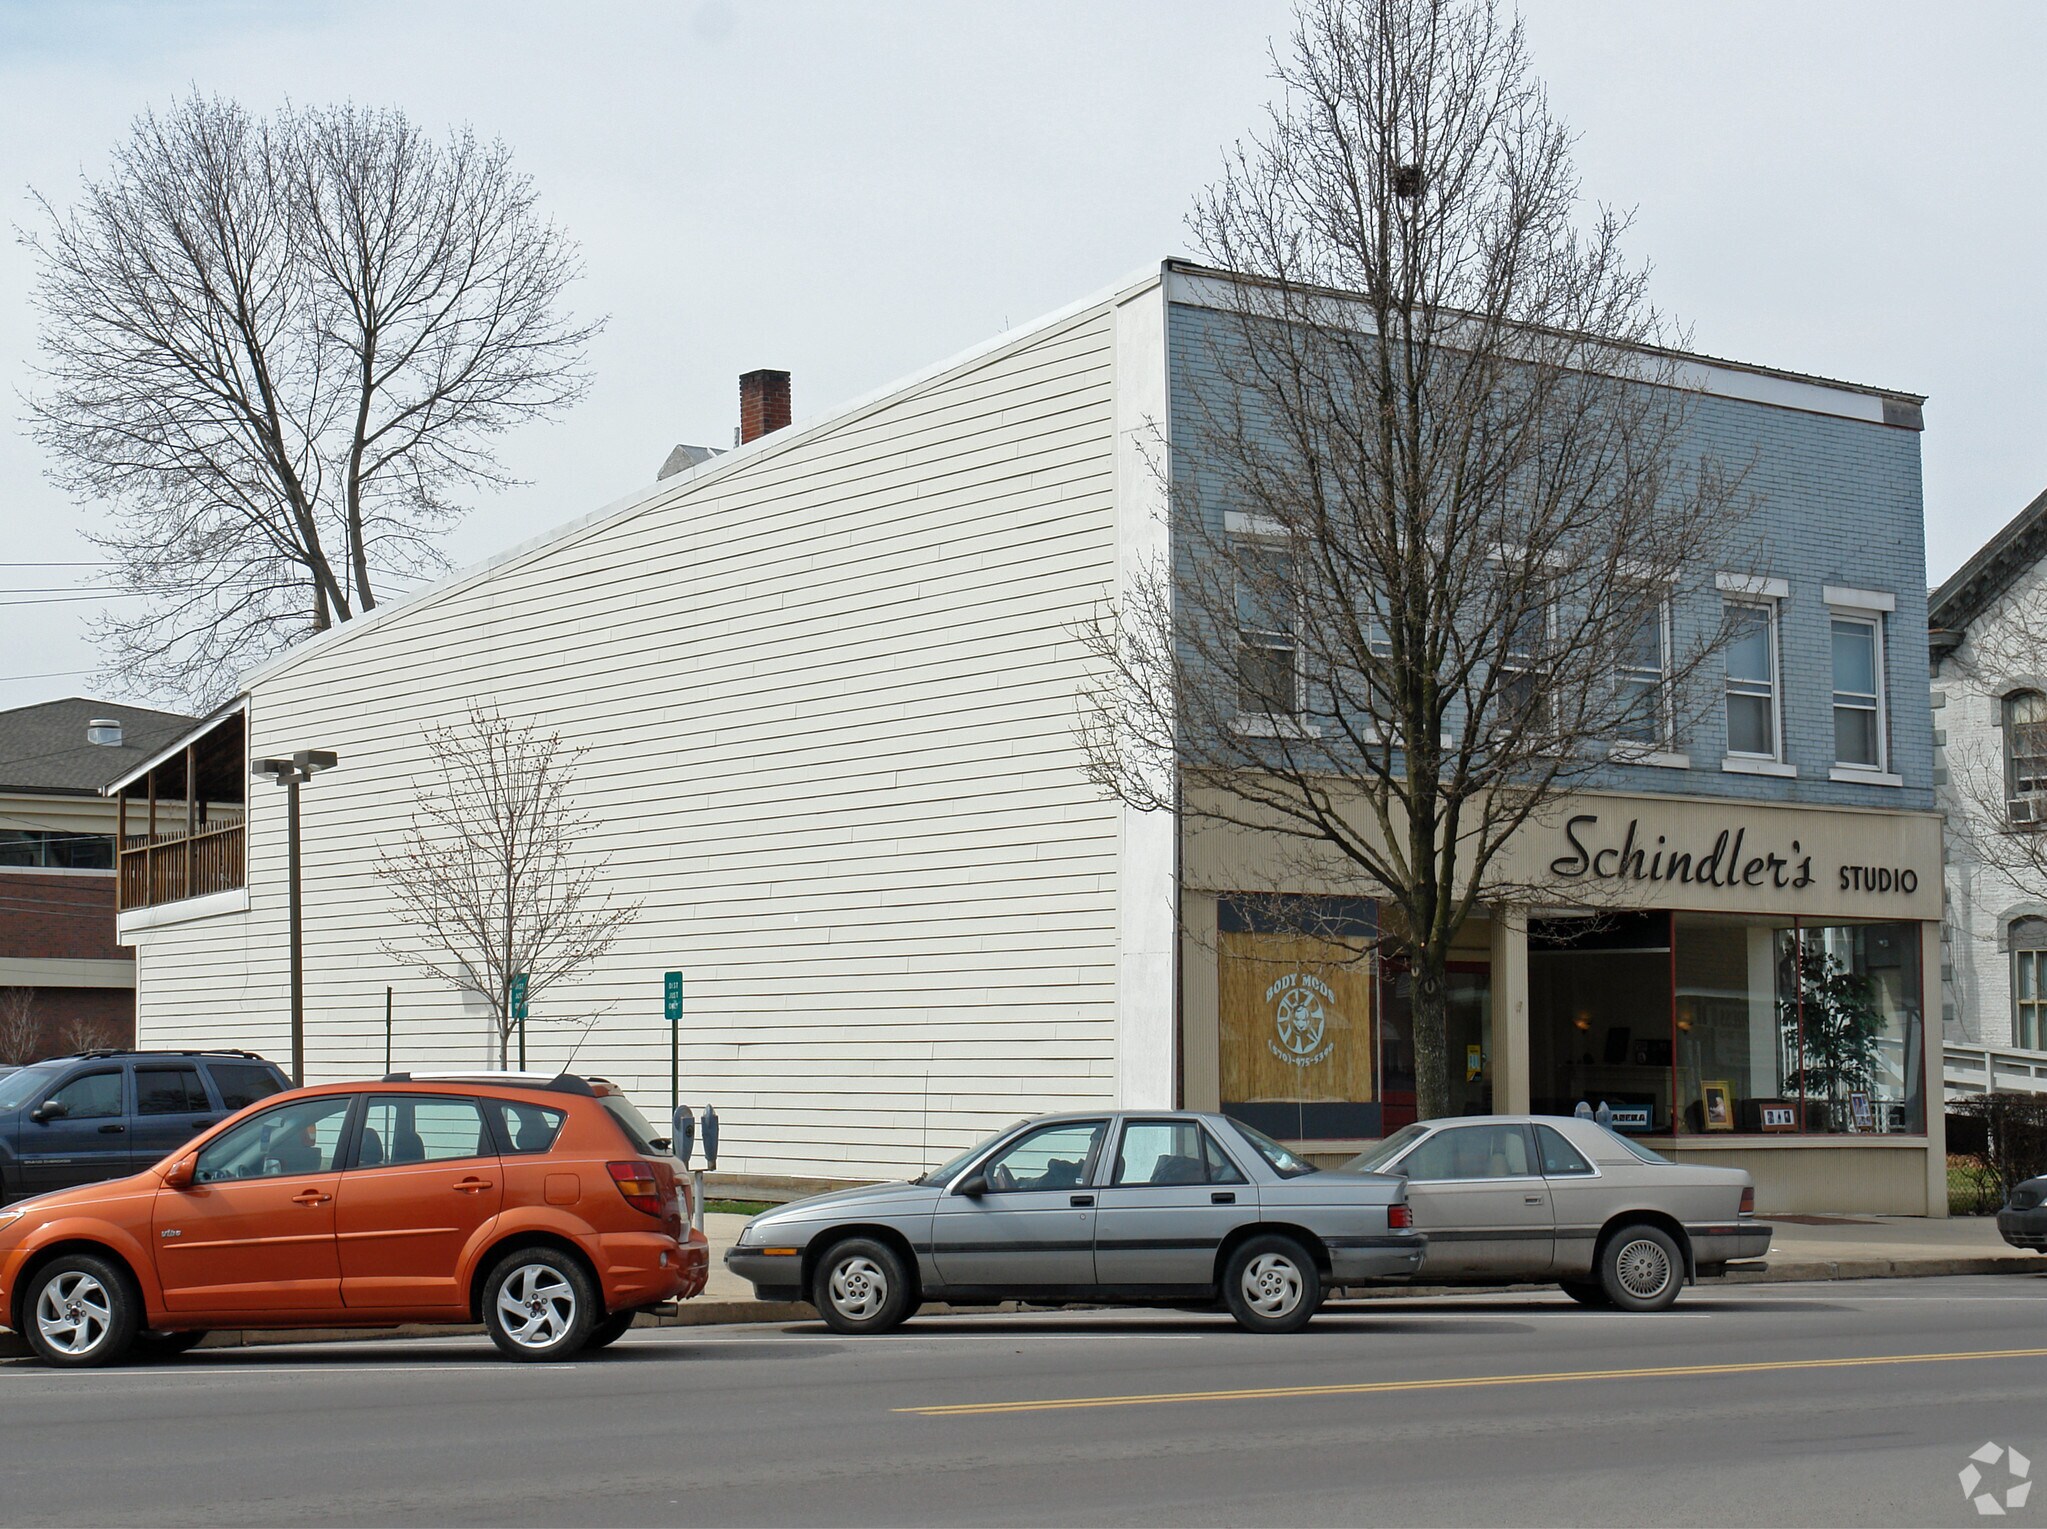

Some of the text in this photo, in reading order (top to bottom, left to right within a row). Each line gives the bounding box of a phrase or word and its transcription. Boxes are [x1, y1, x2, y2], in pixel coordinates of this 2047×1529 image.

[1550, 815, 1918, 894] Schindler's STUDIO
[1265, 973, 1298, 1003] BODY
